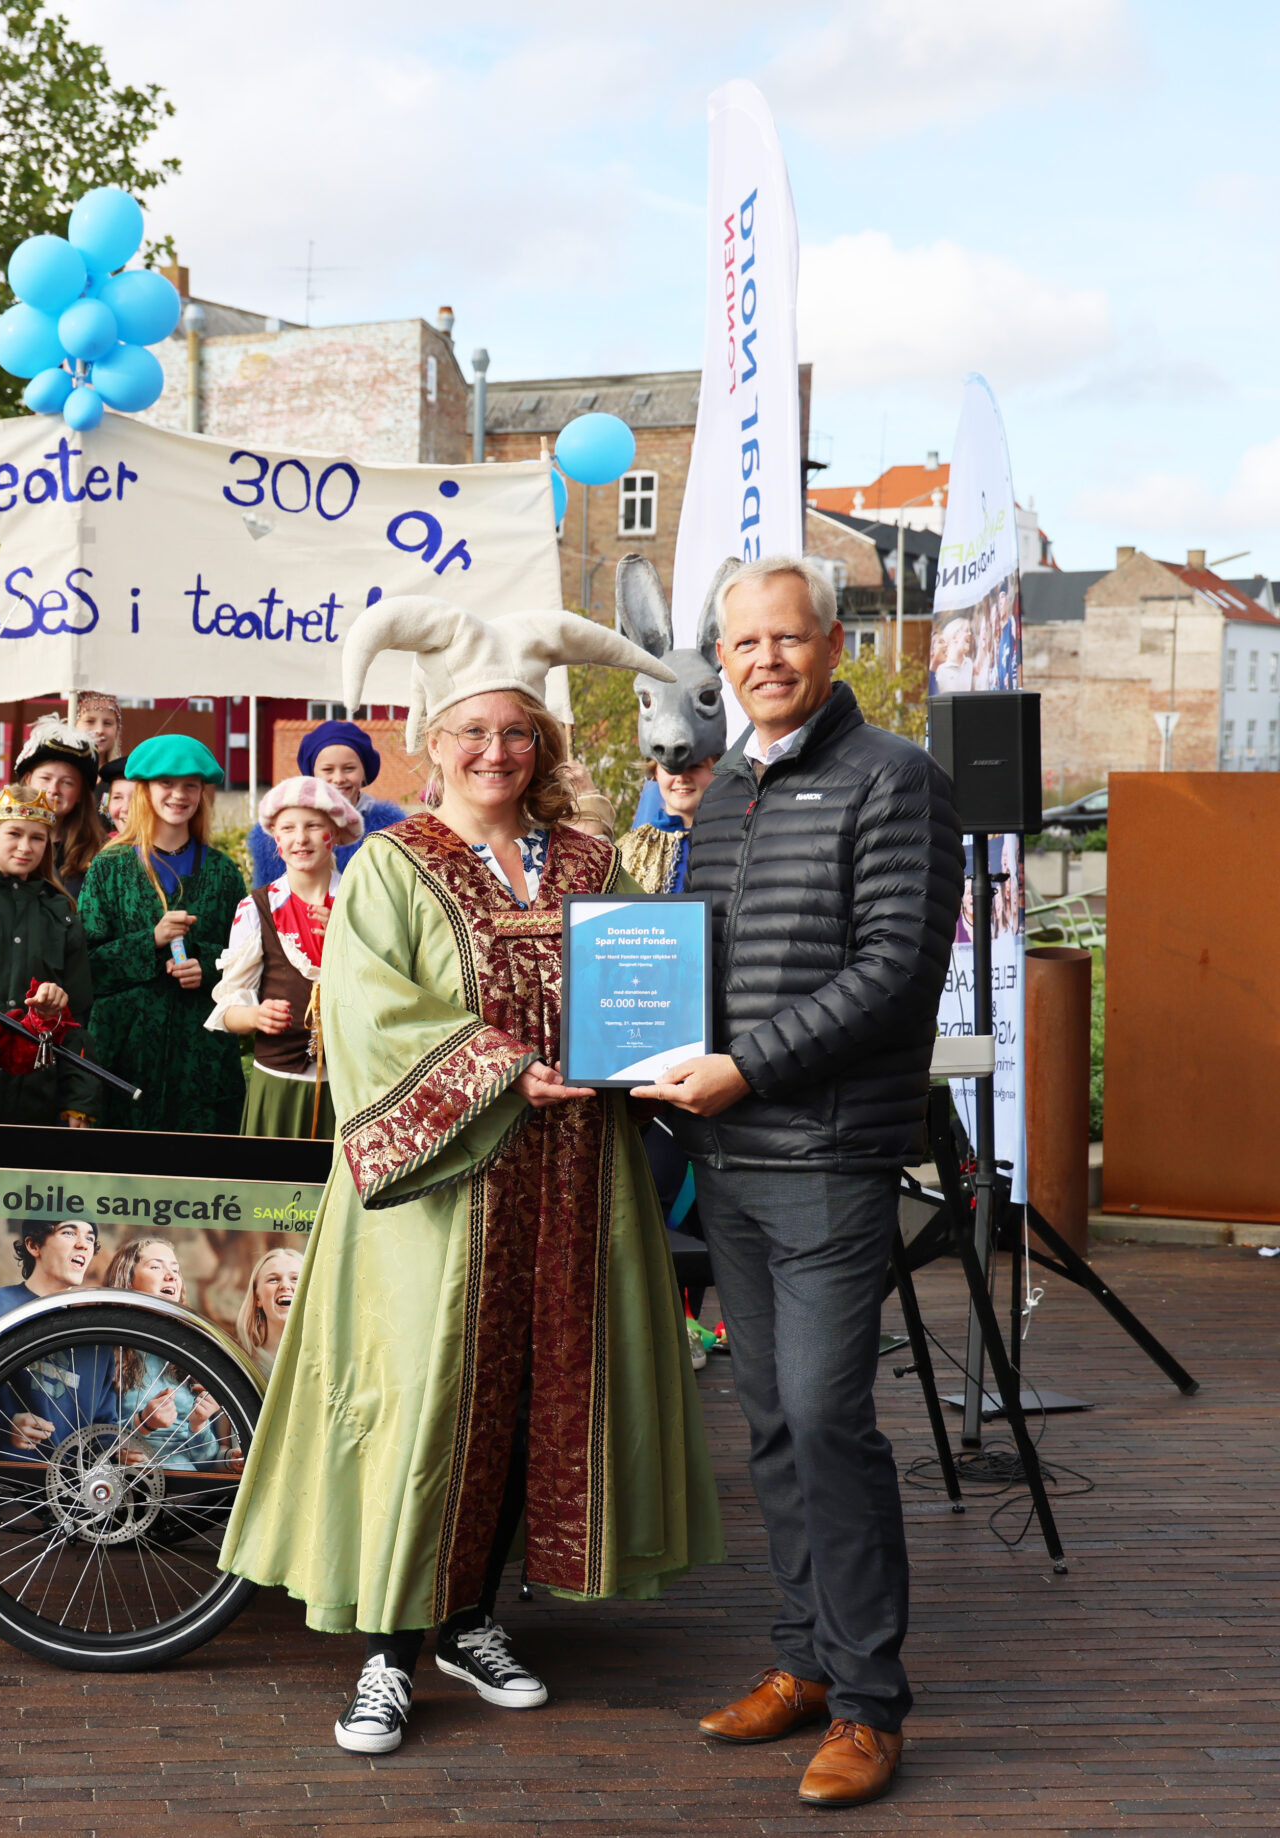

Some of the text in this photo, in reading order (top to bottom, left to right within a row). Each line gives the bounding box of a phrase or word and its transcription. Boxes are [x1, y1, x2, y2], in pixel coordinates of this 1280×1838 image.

[223, 451, 361, 521] 300
[386, 480, 472, 575] år
[131, 587, 140, 634] i
[607, 926, 665, 935] Donation fra
[595, 937, 677, 947] Spar Nord Fonden
[600, 998, 671, 1008] 50.000 kroner
[96, 1195, 242, 1226] sangcafé
